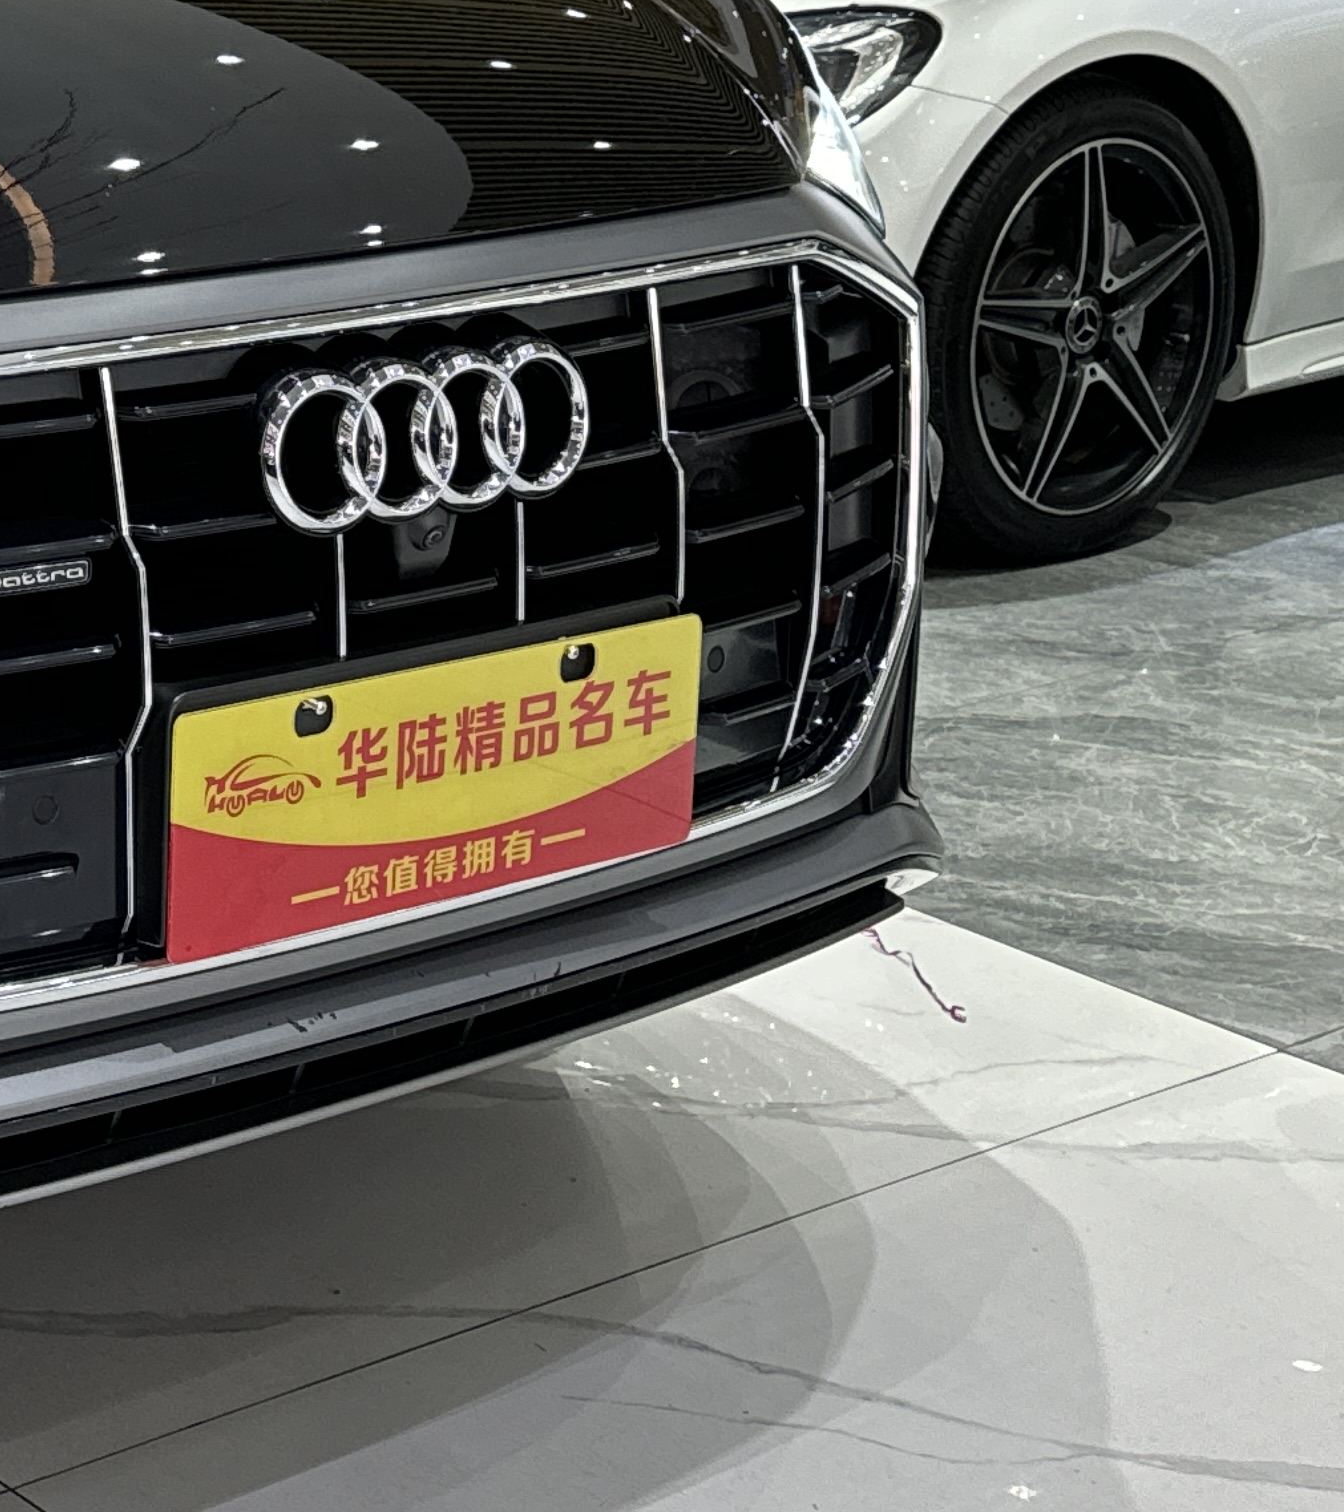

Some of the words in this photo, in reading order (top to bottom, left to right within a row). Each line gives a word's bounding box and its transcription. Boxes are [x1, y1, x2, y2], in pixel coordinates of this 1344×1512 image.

[335, 669, 673, 800] 华陆精品名车
